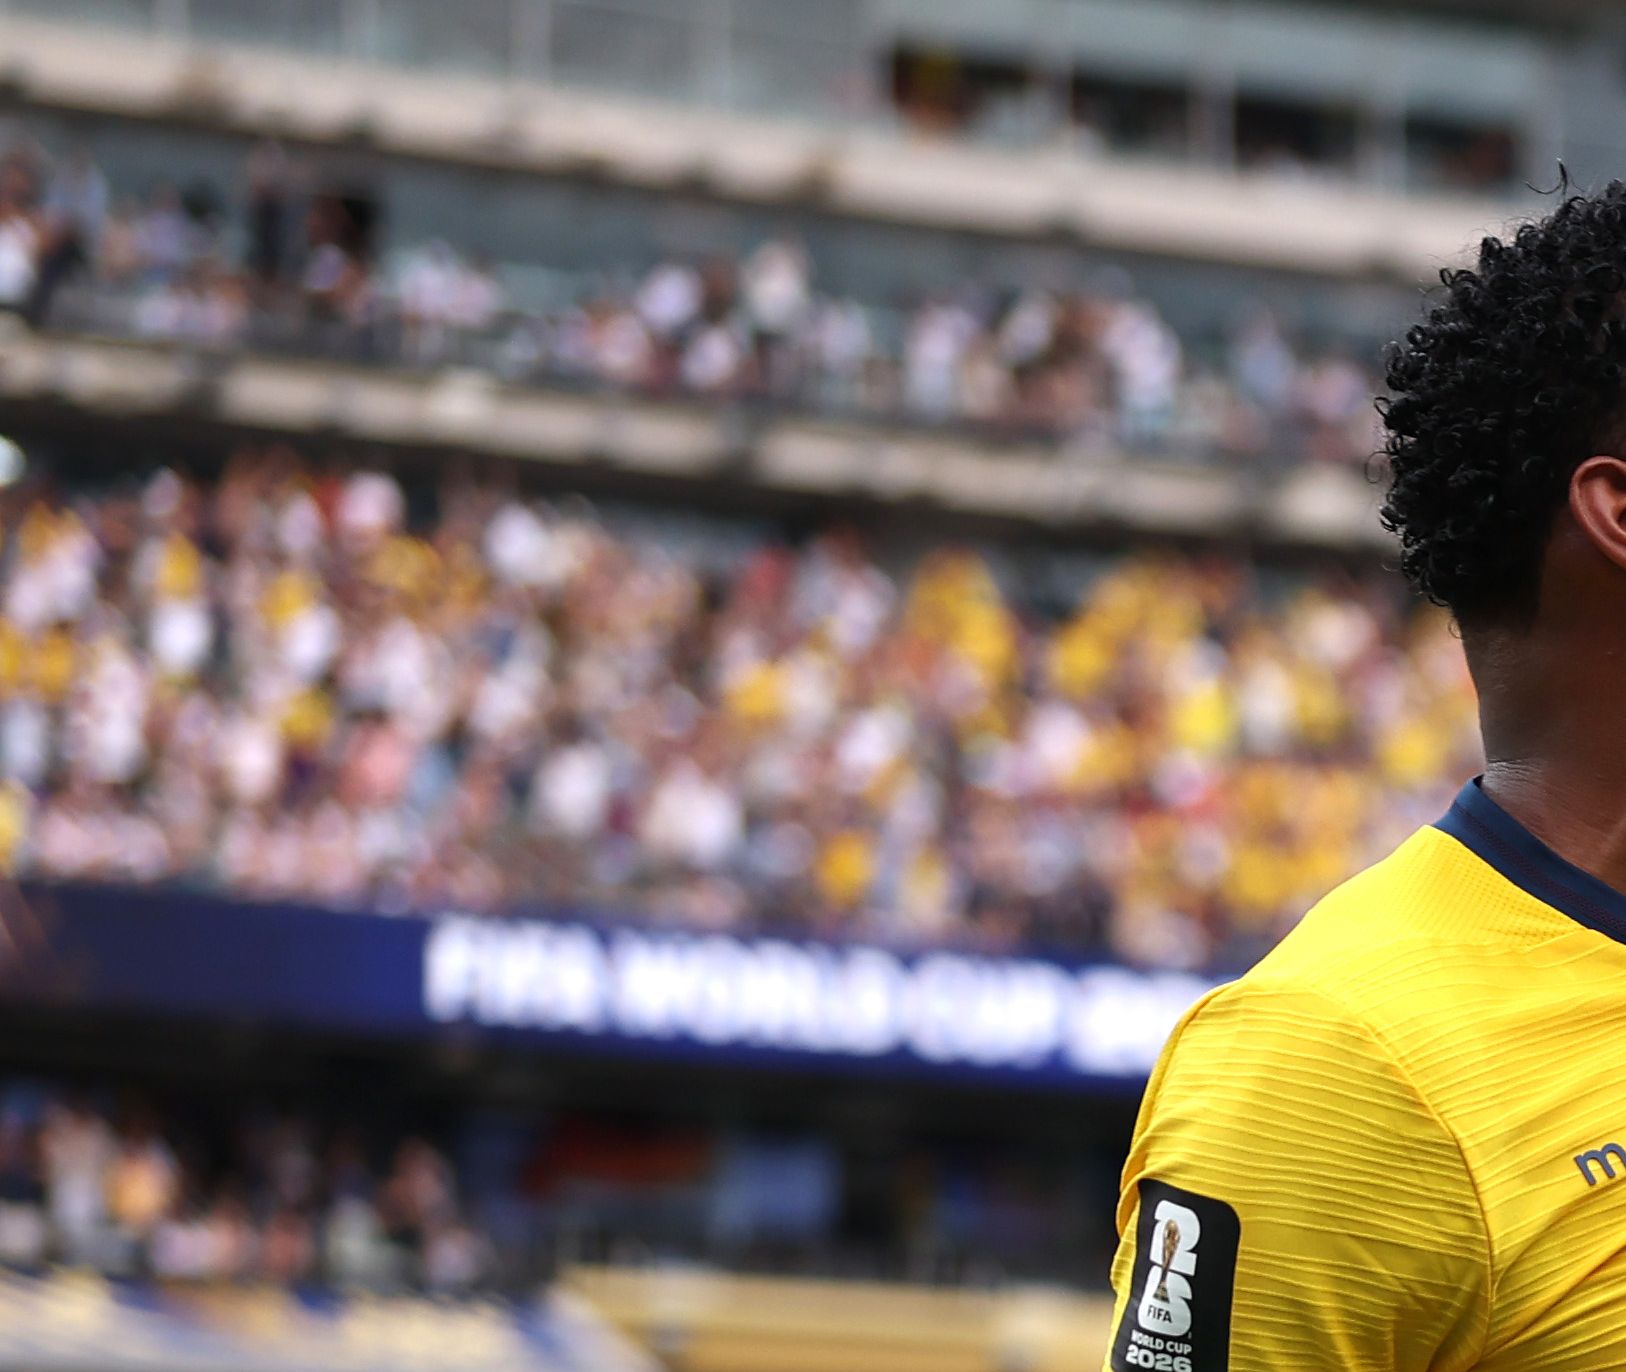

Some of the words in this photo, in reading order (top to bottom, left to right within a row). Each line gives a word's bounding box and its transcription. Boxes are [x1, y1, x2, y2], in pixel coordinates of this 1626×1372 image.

[1147, 1304, 1173, 1323] FIFA
[1131, 1328, 1164, 1351] WORLD
[1166, 1340, 1193, 1355] CUP
